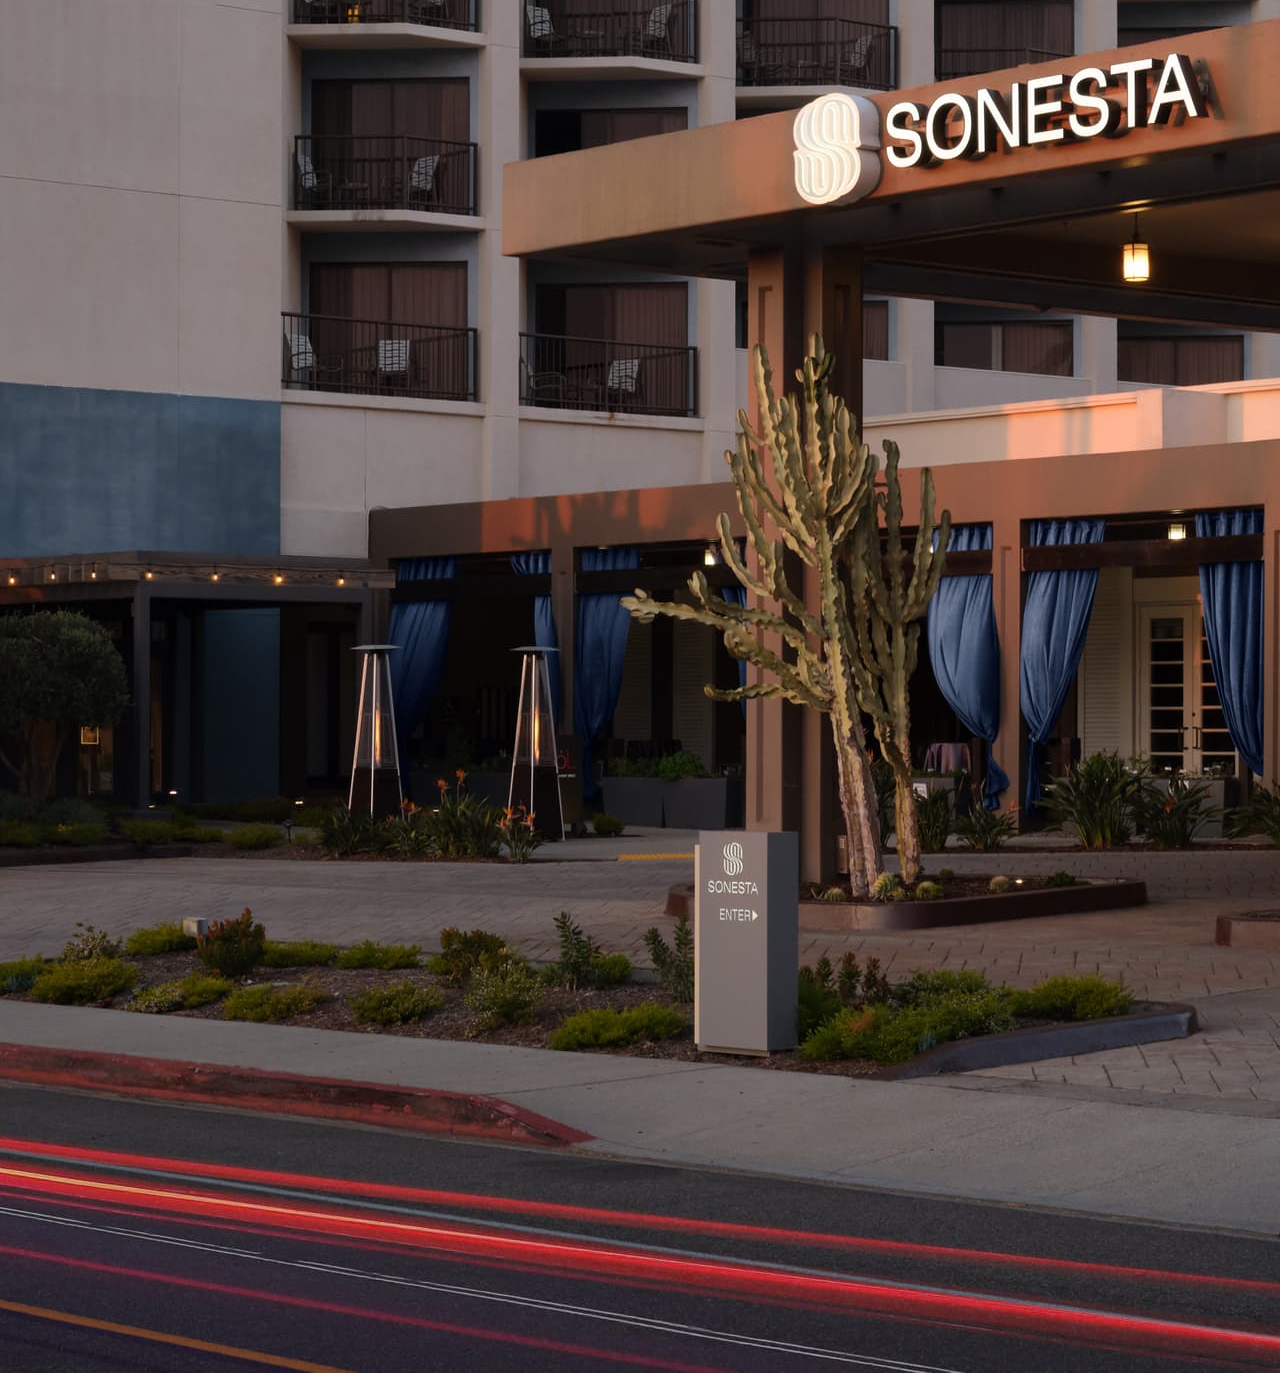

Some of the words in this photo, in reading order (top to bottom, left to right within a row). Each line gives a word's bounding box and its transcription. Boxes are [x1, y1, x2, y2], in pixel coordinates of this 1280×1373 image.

[885, 52, 1201, 169] SONESTA
[707, 880, 759, 895] SONESTA
[719, 908, 751, 921] ENTER
